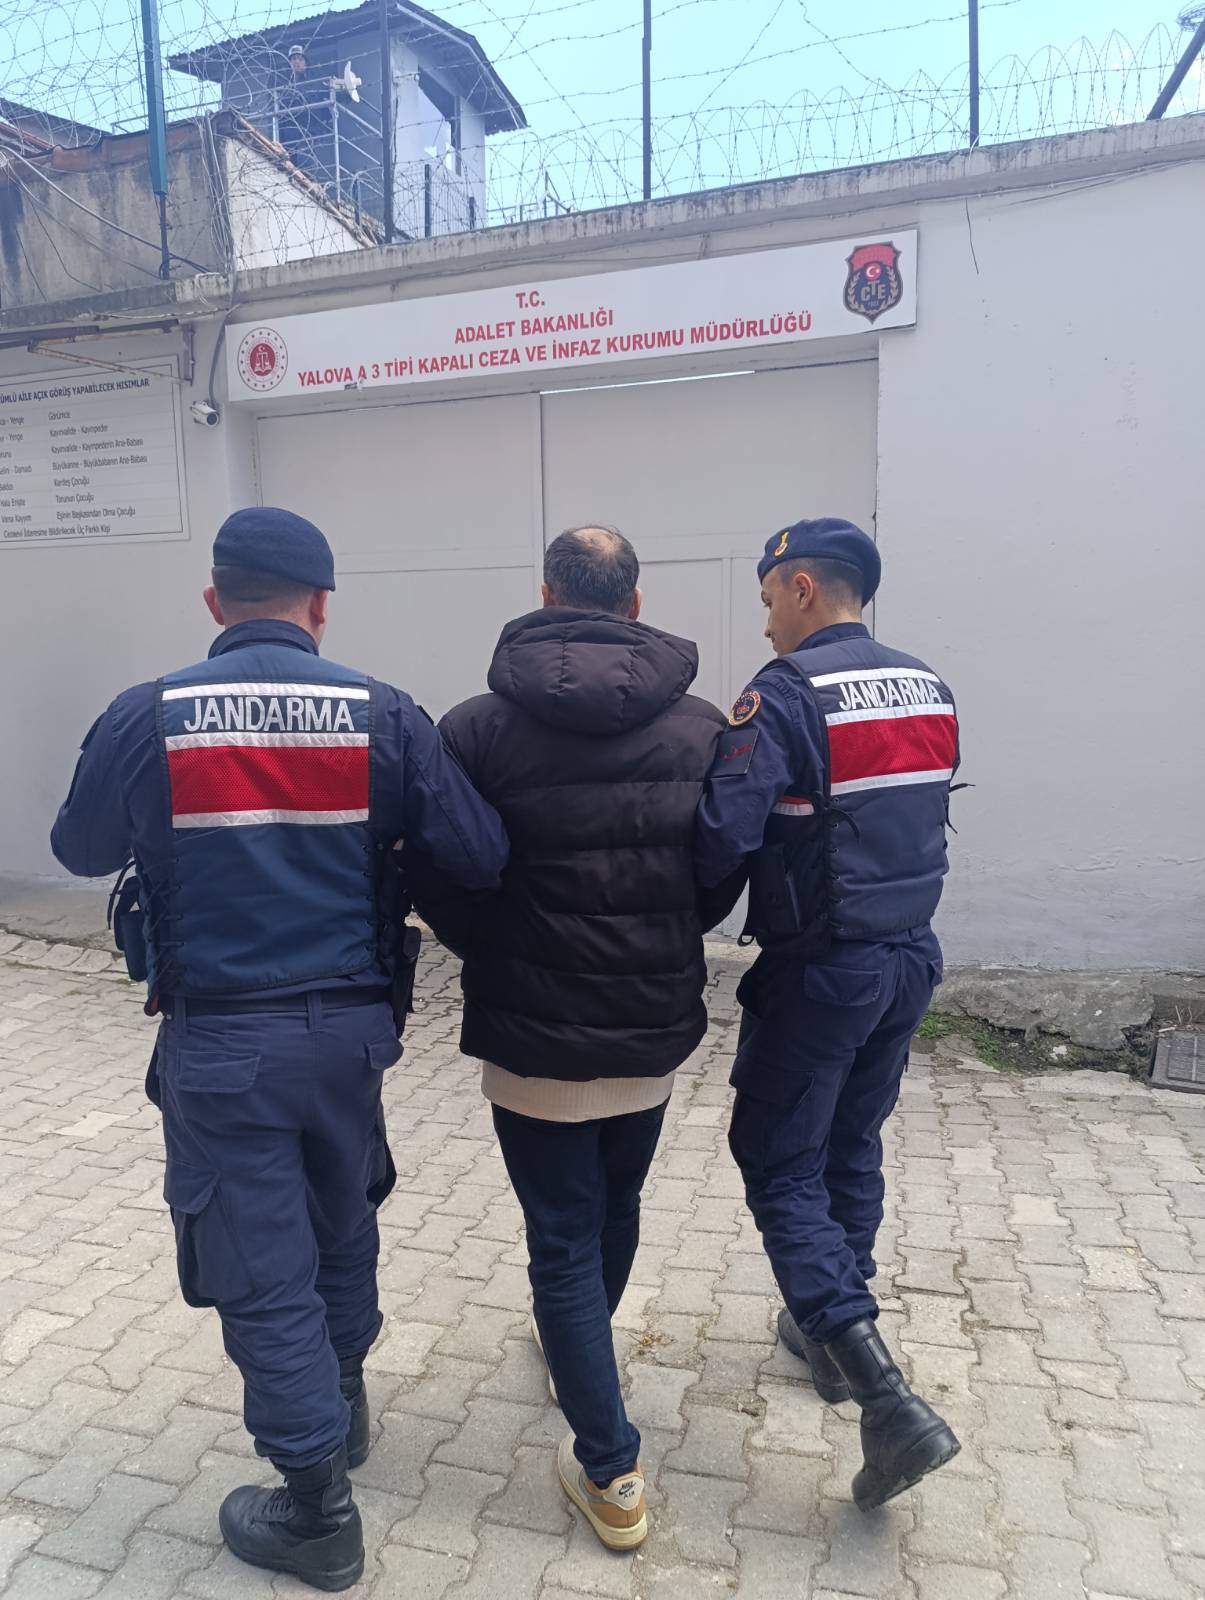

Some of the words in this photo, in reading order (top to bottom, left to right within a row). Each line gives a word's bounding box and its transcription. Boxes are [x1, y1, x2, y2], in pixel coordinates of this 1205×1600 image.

[516, 291, 545, 309] T.C.
[454, 321, 516, 344] ADALET
[521, 307, 614, 336] BAKANLIĞI
[298, 367, 353, 387] YALOVA
[358, 365, 367, 381] A
[372, 364, 380, 379] 3
[384, 356, 413, 378] TİPİ
[419, 353, 473, 374] KAPALI
[479, 348, 520, 367] CEZA
[525, 345, 547, 362] VE
[553, 339, 601, 360] İNFAZ
[607, 329, 684, 354] KURUMU
[690, 310, 812, 344] MÜDÜRLÜĞÜ
[0, 392, 17, 404] ÜMLÜ
[18, 391, 32, 402] AİLE
[33, 390, 48, 401] AÇIK
[49, 387, 71, 399] GÖRÜŞ
[72, 382, 116, 396] YAPABİLECEK
[839, 677, 943, 711] JANDARMA
[184, 696, 355, 732] JANDARMA
[624, 1490, 635, 1500] AIR
